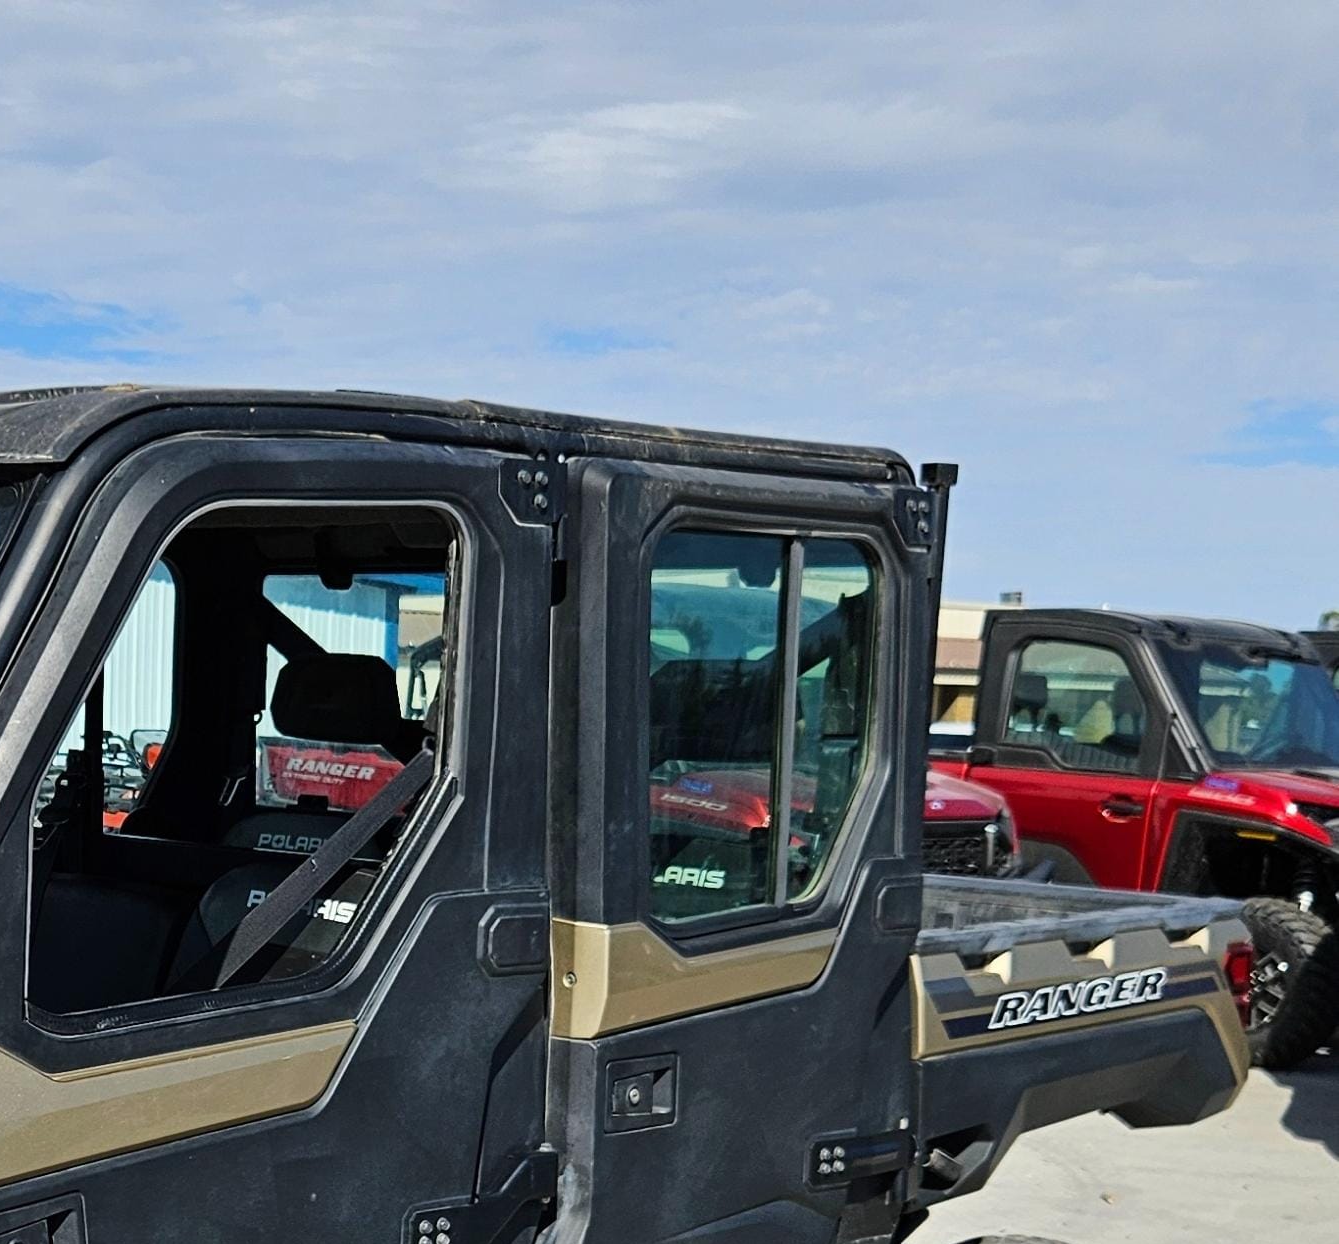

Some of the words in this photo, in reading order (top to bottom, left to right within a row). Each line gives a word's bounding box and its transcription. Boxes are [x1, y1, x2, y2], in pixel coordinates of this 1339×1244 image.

[287, 757, 377, 780] RANGER
[258, 833, 329, 851] POLAR
[986, 966, 1167, 1030] RANGER
